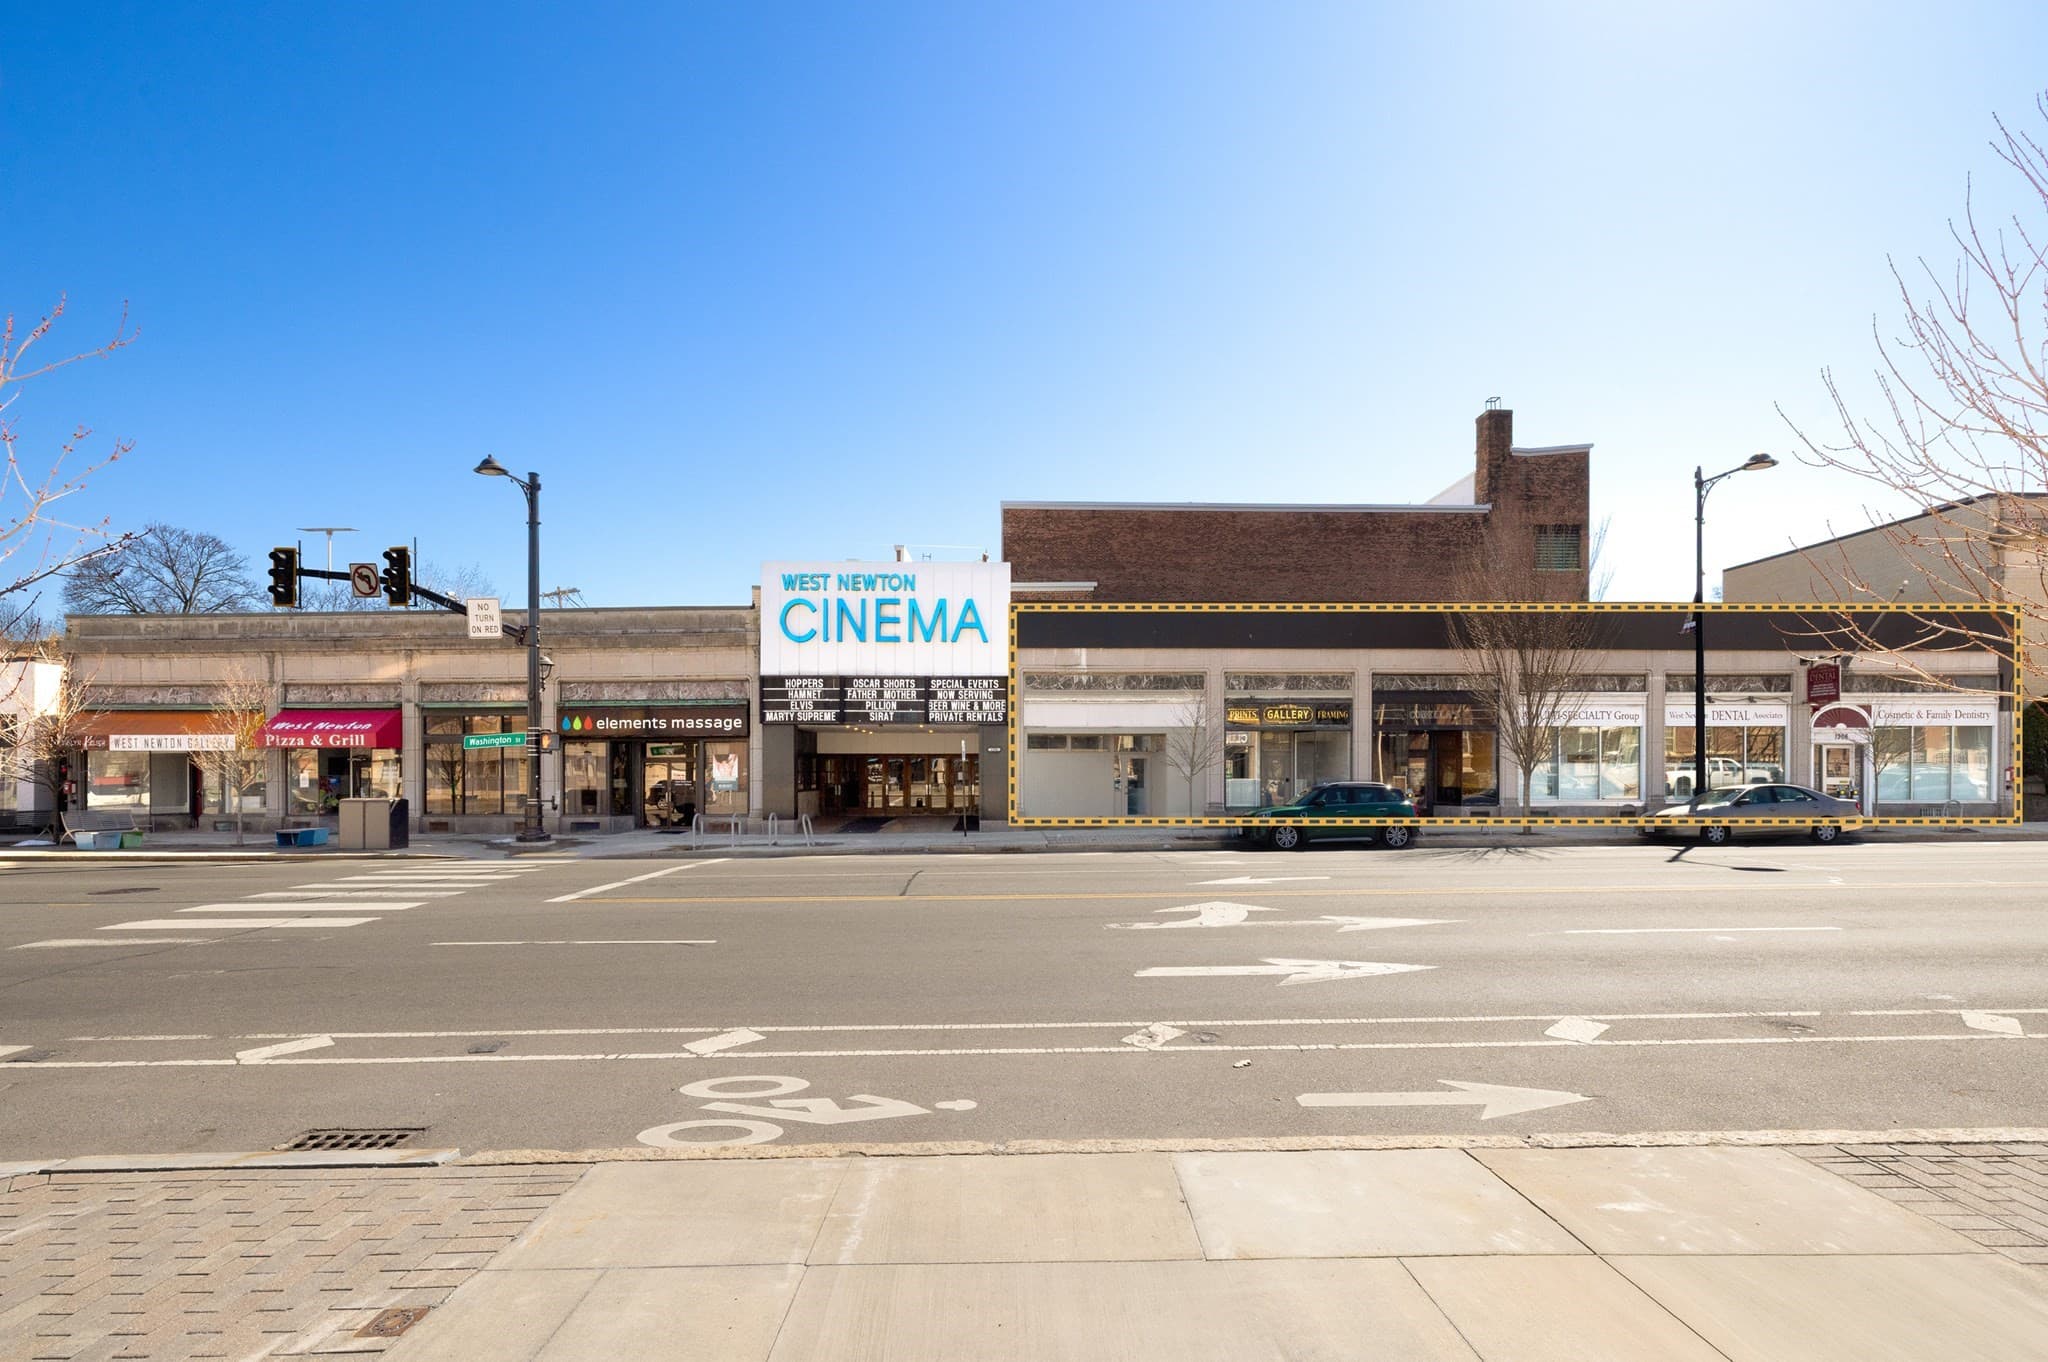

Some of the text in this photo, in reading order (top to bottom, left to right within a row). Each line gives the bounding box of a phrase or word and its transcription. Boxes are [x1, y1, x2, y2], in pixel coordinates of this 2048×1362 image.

[781, 573, 915, 592] WEST NEWTON
[477, 603, 489, 611] NO
[475, 614, 494, 622] TURN
[779, 598, 989, 644] CINEMA
[471, 625, 499, 633] ON RED
[785, 679, 824, 688] HOPPERS
[853, 679, 916, 688] OSCAR SHORTS
[930, 679, 999, 689] SPECIAL EVENTS
[788, 690, 822, 699] HAMNET
[847, 690, 917, 699] FATHER MOTHER
[937, 690, 994, 700] NOW SERVING
[790, 701, 814, 710] ELVIS
[865, 701, 897, 710] PILLION
[928, 701, 1006, 711] BEER WINE & MORE
[765, 712, 837, 721] MARTY SUPREME
[869, 712, 894, 721] SIRAT
[928, 712, 1004, 722] PRIVATE RENTALS
[1229, 710, 1257, 719] PRINTS
[1267, 710, 1309, 719] GALLERY
[1317, 711, 1349, 719] FRAMING
[1614, 711, 1640, 723] Group
[1669, 711, 1684, 719] West
[1711, 710, 1750, 721] DENTAL
[1753, 711, 1784, 719] Associates
[1878, 709, 1992, 721] Cosmetic & Family Dentistry
[272, 721, 373, 730] West Newton
[596, 717, 742, 731] elements massage
[114, 738, 138, 748] WEST
[144, 738, 182, 748] NEWTON
[265, 734, 365, 746] Pizza & Grill
[469, 737, 512, 747] Washington
